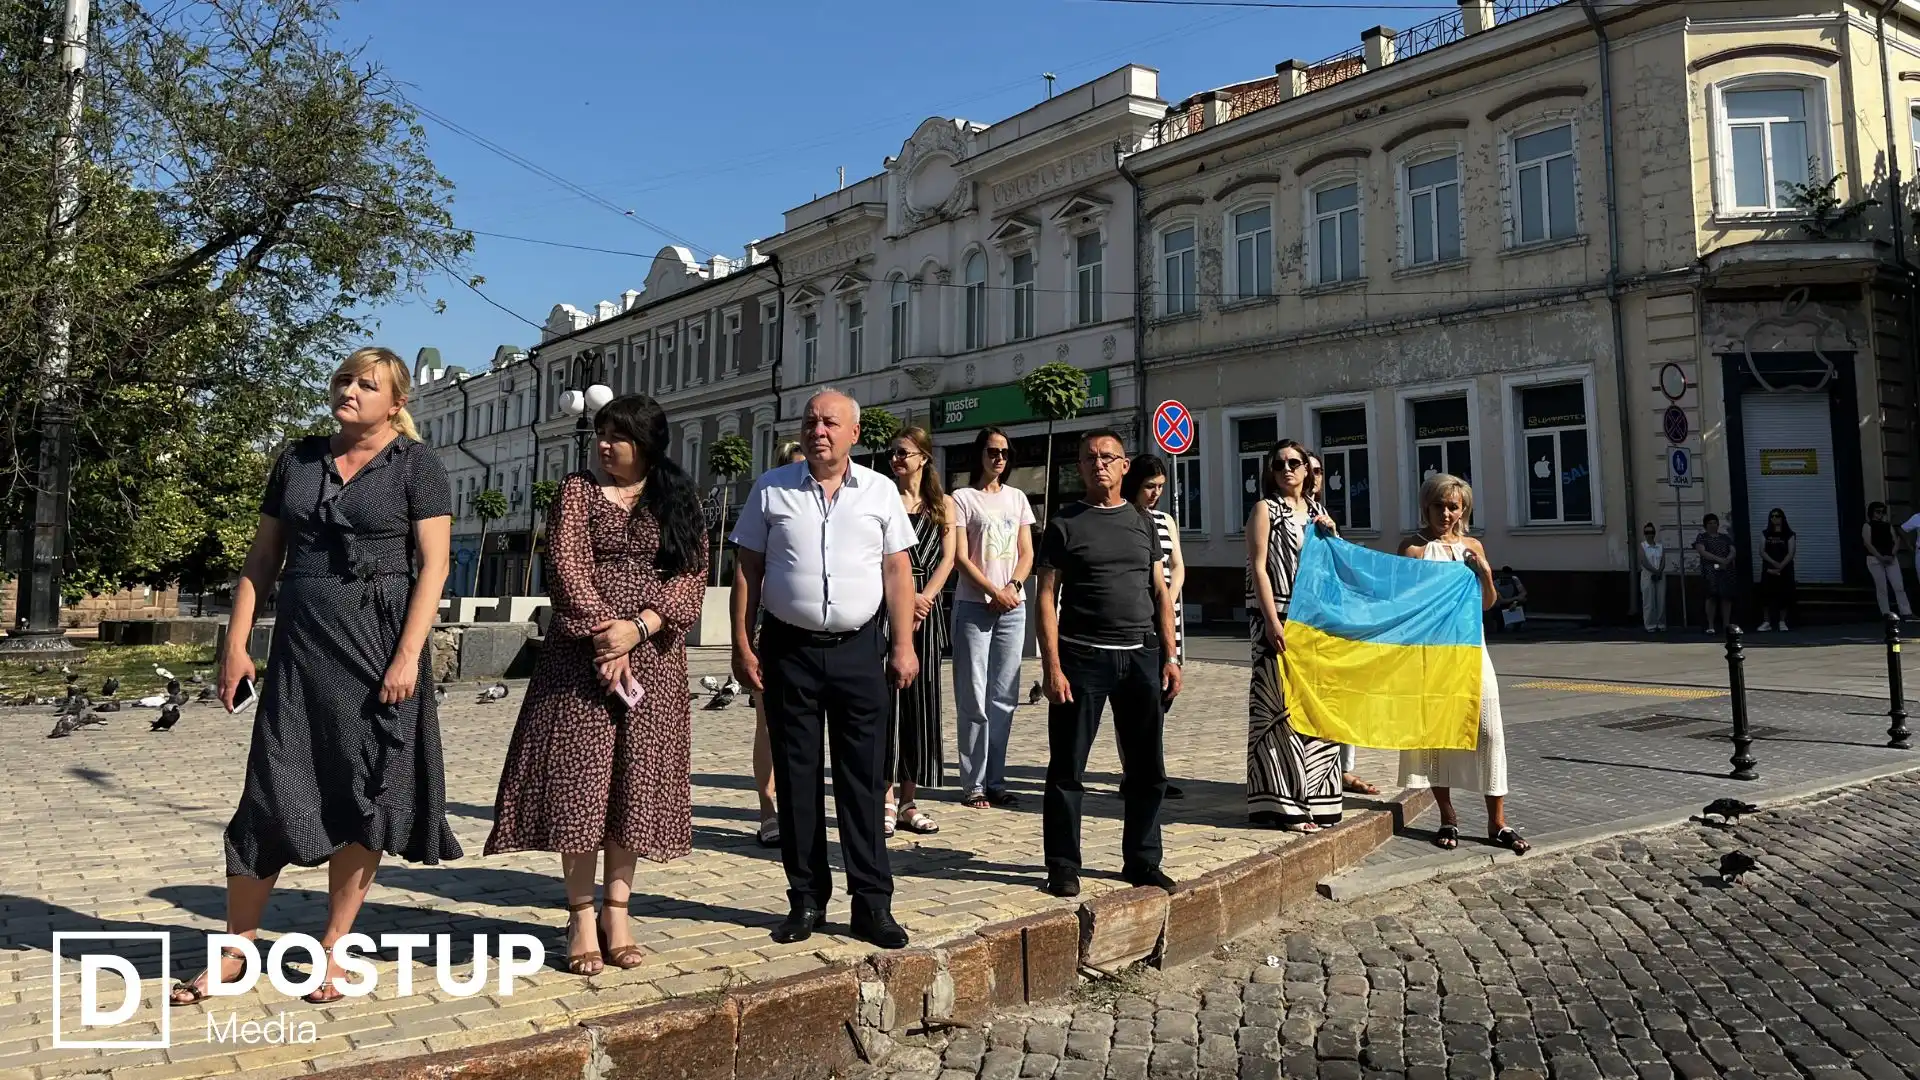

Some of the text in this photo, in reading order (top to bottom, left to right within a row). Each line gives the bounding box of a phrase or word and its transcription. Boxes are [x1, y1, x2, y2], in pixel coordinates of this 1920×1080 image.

[945, 396, 980, 412] master
[945, 412, 963, 424] zoo
[1673, 476, 1689, 484] ЗОНА
